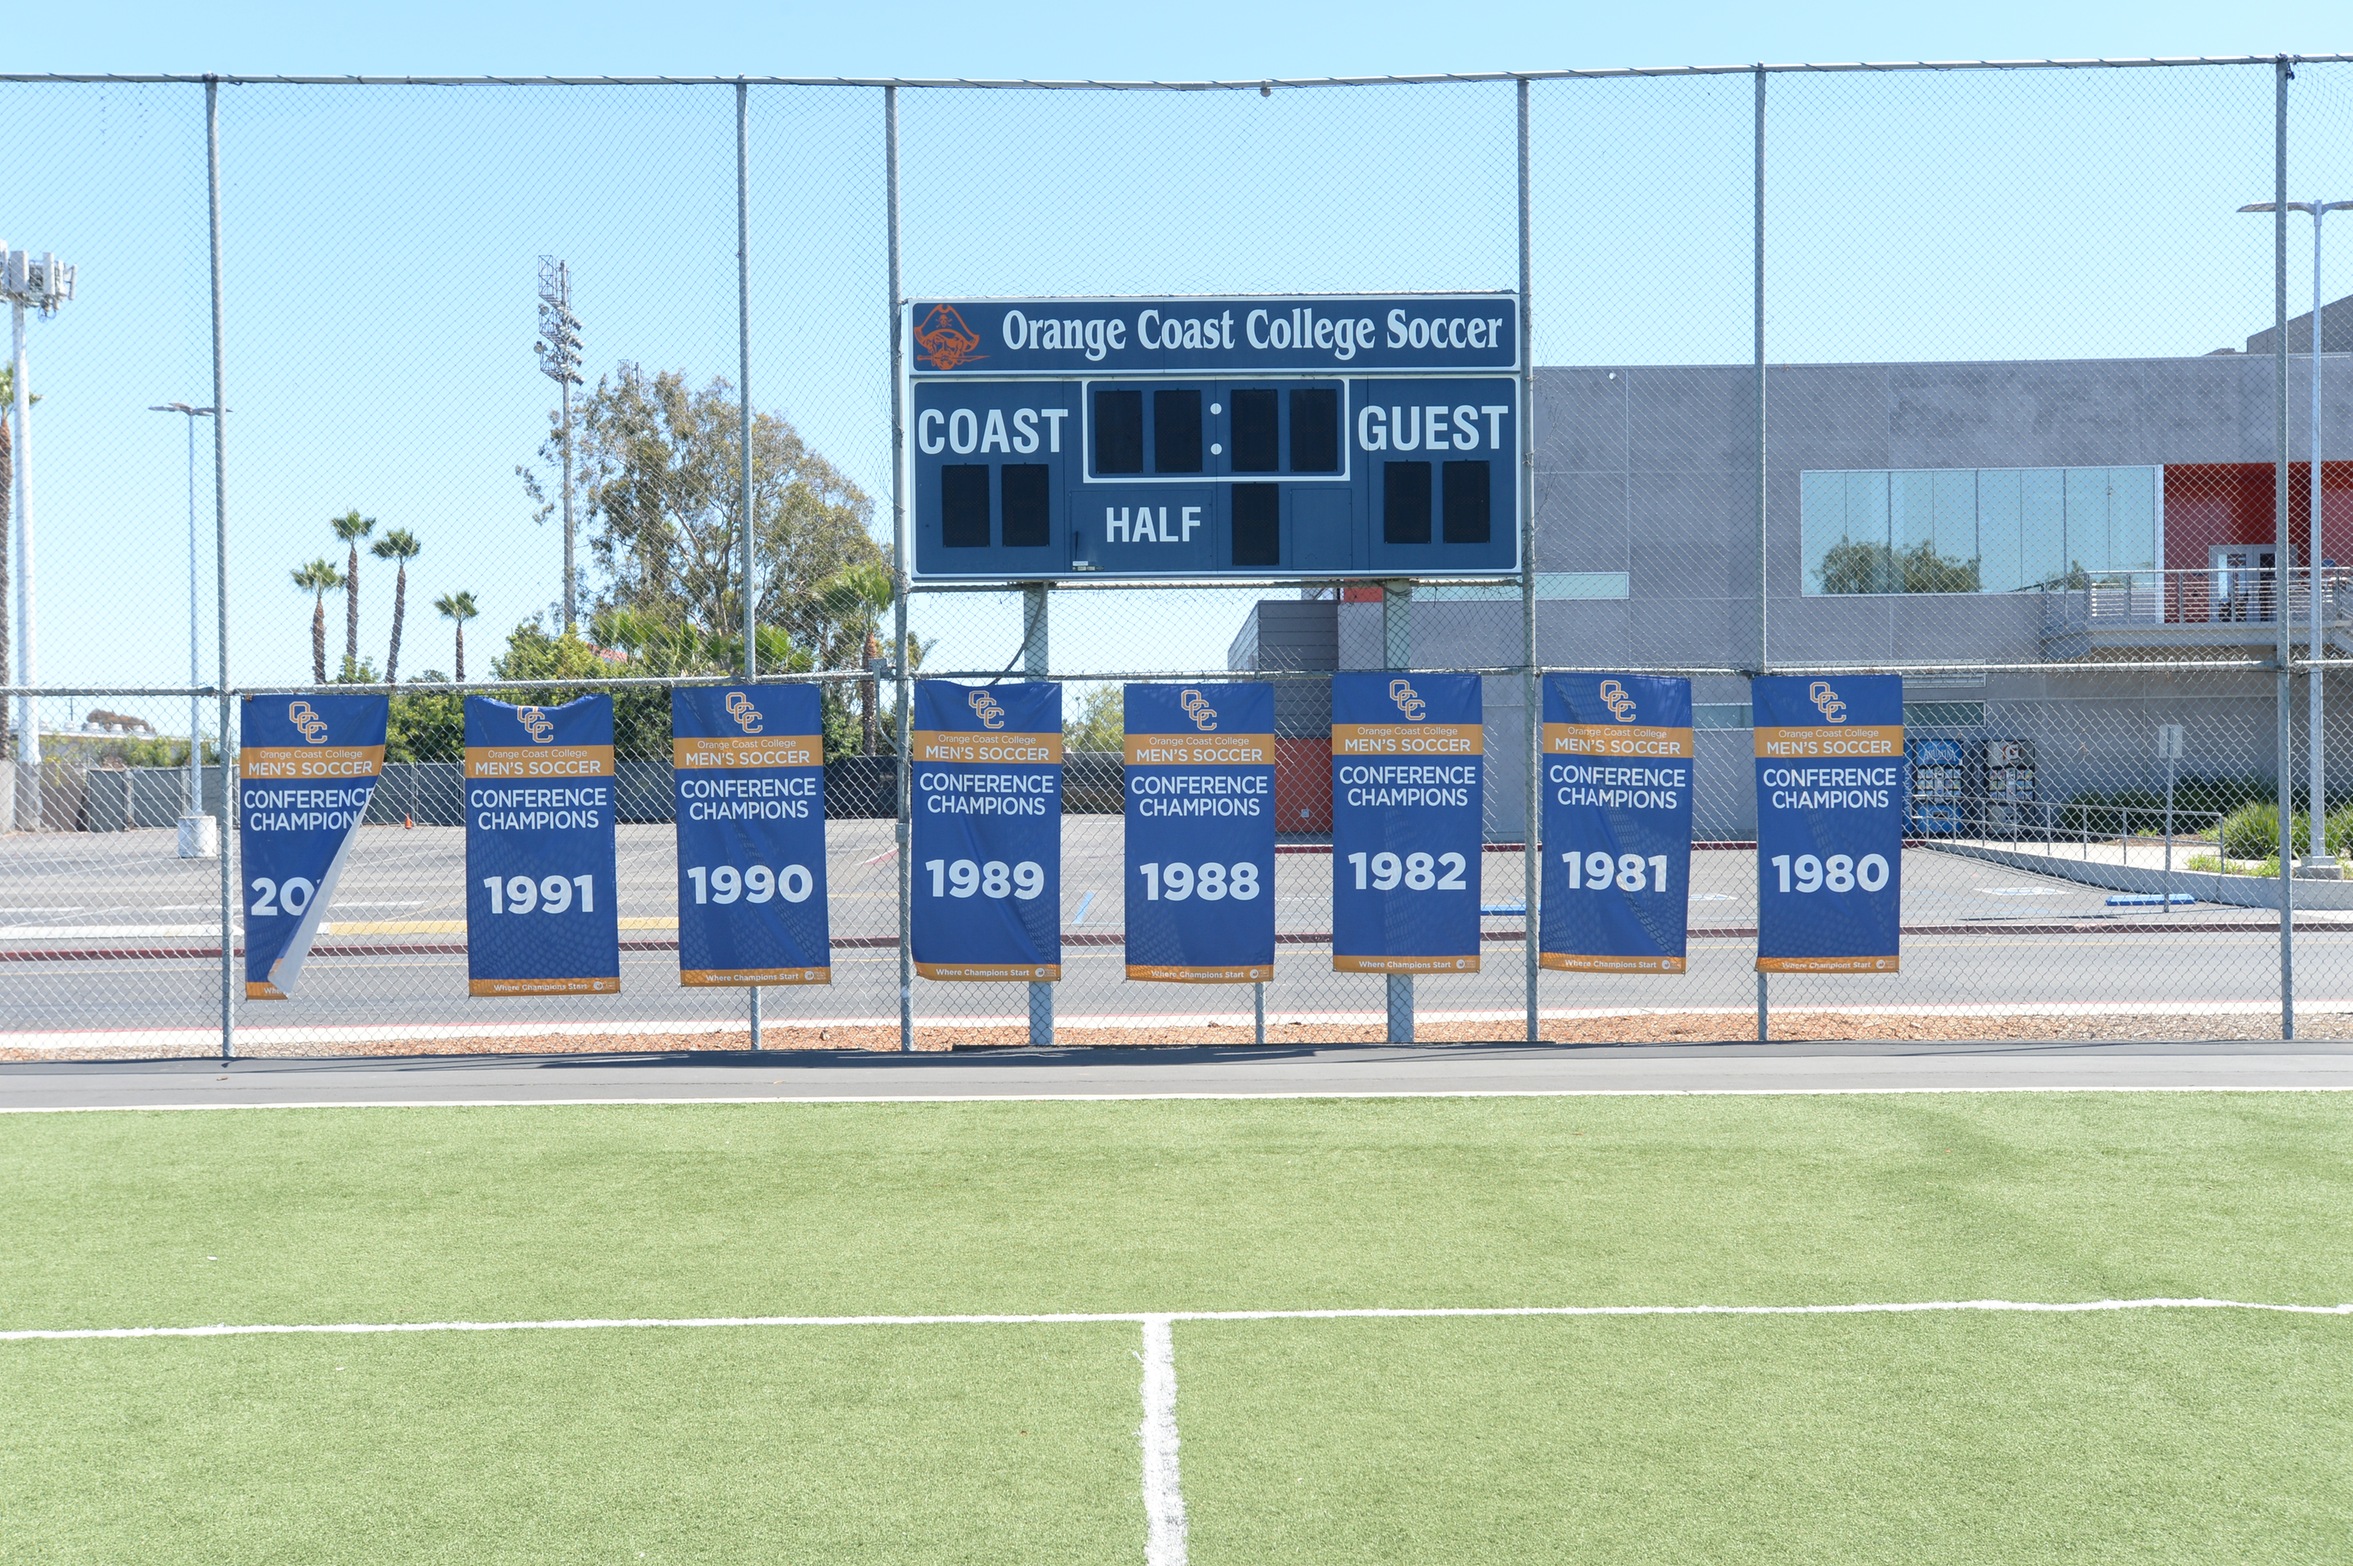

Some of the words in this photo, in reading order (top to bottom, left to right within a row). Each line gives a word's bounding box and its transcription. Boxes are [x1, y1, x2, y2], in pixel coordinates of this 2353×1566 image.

[1003, 309, 1126, 361] Orange
[1138, 309, 1235, 350] Coast
[1247, 308, 1376, 361] College
[1387, 309, 1502, 349] Soccer
[919, 409, 1068, 454] COAST
[1359, 405, 1508, 451] GUEST
[1106, 506, 1201, 542] HALF
[1389, 679, 1426, 721] OCC
[1600, 680, 1636, 722] OCC
[1809, 682, 1846, 724] OCC
[725, 692, 763, 733] OCC
[968, 691, 1004, 729] OCC
[1181, 689, 1217, 731] OCC
[289, 701, 328, 744] OCC
[1358, 727, 1392, 736] Orange
[1394, 727, 1421, 735] Coast
[1424, 727, 1458, 736] College
[938, 735, 970, 744] Orange
[972, 735, 999, 744] Coast
[1002, 736, 1036, 745] College
[1149, 737, 1183, 746] Orange
[1186, 737, 1212, 745] Coast
[1215, 737, 1249, 746] College
[1568, 727, 1601, 737] Orange
[1604, 728, 1630, 736] Coast
[1634, 729, 1666, 739] College
[1779, 730, 1812, 740] Orange
[1816, 730, 1842, 738] Coast
[1846, 729, 1879, 738] College
[698, 740, 729, 750] Orange
[732, 740, 758, 748] Coast
[761, 739, 796, 749] College
[926, 746, 974, 759] MEN'S
[979, 748, 1049, 760] SOCCER
[1346, 739, 1397, 752] MEN'S
[1401, 739, 1471, 752] SOCCER
[1555, 738, 1605, 752] MEN'S
[1611, 741, 1680, 754] SOCCER
[1767, 742, 1818, 754] MEN'S
[1824, 741, 1892, 754] SOCCER
[260, 751, 291, 760] Orange
[294, 750, 322, 758] Coast
[326, 750, 362, 759] College
[488, 750, 518, 760] Orange
[522, 750, 548, 758] Coast
[552, 749, 588, 759] College
[686, 752, 735, 766] MEN'S
[740, 751, 810, 764] SOCCER
[1136, 750, 1188, 762] MEN'S
[1193, 750, 1262, 762] SOCCER
[249, 762, 296, 775] MEN'S
[302, 761, 372, 775] SOCCER
[476, 762, 524, 775] MEN'S
[529, 761, 600, 774] SOCCER
[1340, 766, 1476, 784] CONFERENCE
[1550, 765, 1686, 788] CONFERENCE
[1763, 768, 1896, 787] CONFERENCE
[681, 778, 816, 799] CONFERENCE
[920, 773, 1053, 794] CONFERENCE
[1131, 776, 1268, 795] CONFERENCE
[471, 787, 607, 808] CONFERENCE
[928, 795, 1045, 816] CHAMPIONS
[1139, 798, 1260, 816] CHAMPIONS
[1347, 788, 1468, 807] CHAMPIONS
[1557, 787, 1677, 810] CHAMPIONS
[1772, 790, 1888, 810] CHAMPIONS
[690, 800, 808, 820] CHAMPIONS
[478, 810, 599, 830] CHAMPIONS
[926, 859, 1045, 900] 1989
[1349, 852, 1466, 891] 1982
[1562, 851, 1668, 892] 1981
[1772, 854, 1890, 893] 1980
[687, 864, 813, 904] 1990
[1140, 862, 1260, 901] 1988
[251, 877, 321, 916] 20
[484, 875, 593, 915] 1991
[964, 969, 1008, 977] Champions
[1387, 961, 1431, 969] Champions
[1565, 960, 1591, 968] Where
[1594, 960, 1636, 969] Champions
[1782, 962, 1807, 970] Where
[1810, 962, 1852, 970] Champions
[706, 974, 732, 982] Where
[733, 974, 778, 982] Champions
[1180, 971, 1223, 979] Champions
[494, 984, 520, 992] Where
[522, 984, 566, 992] Champions
